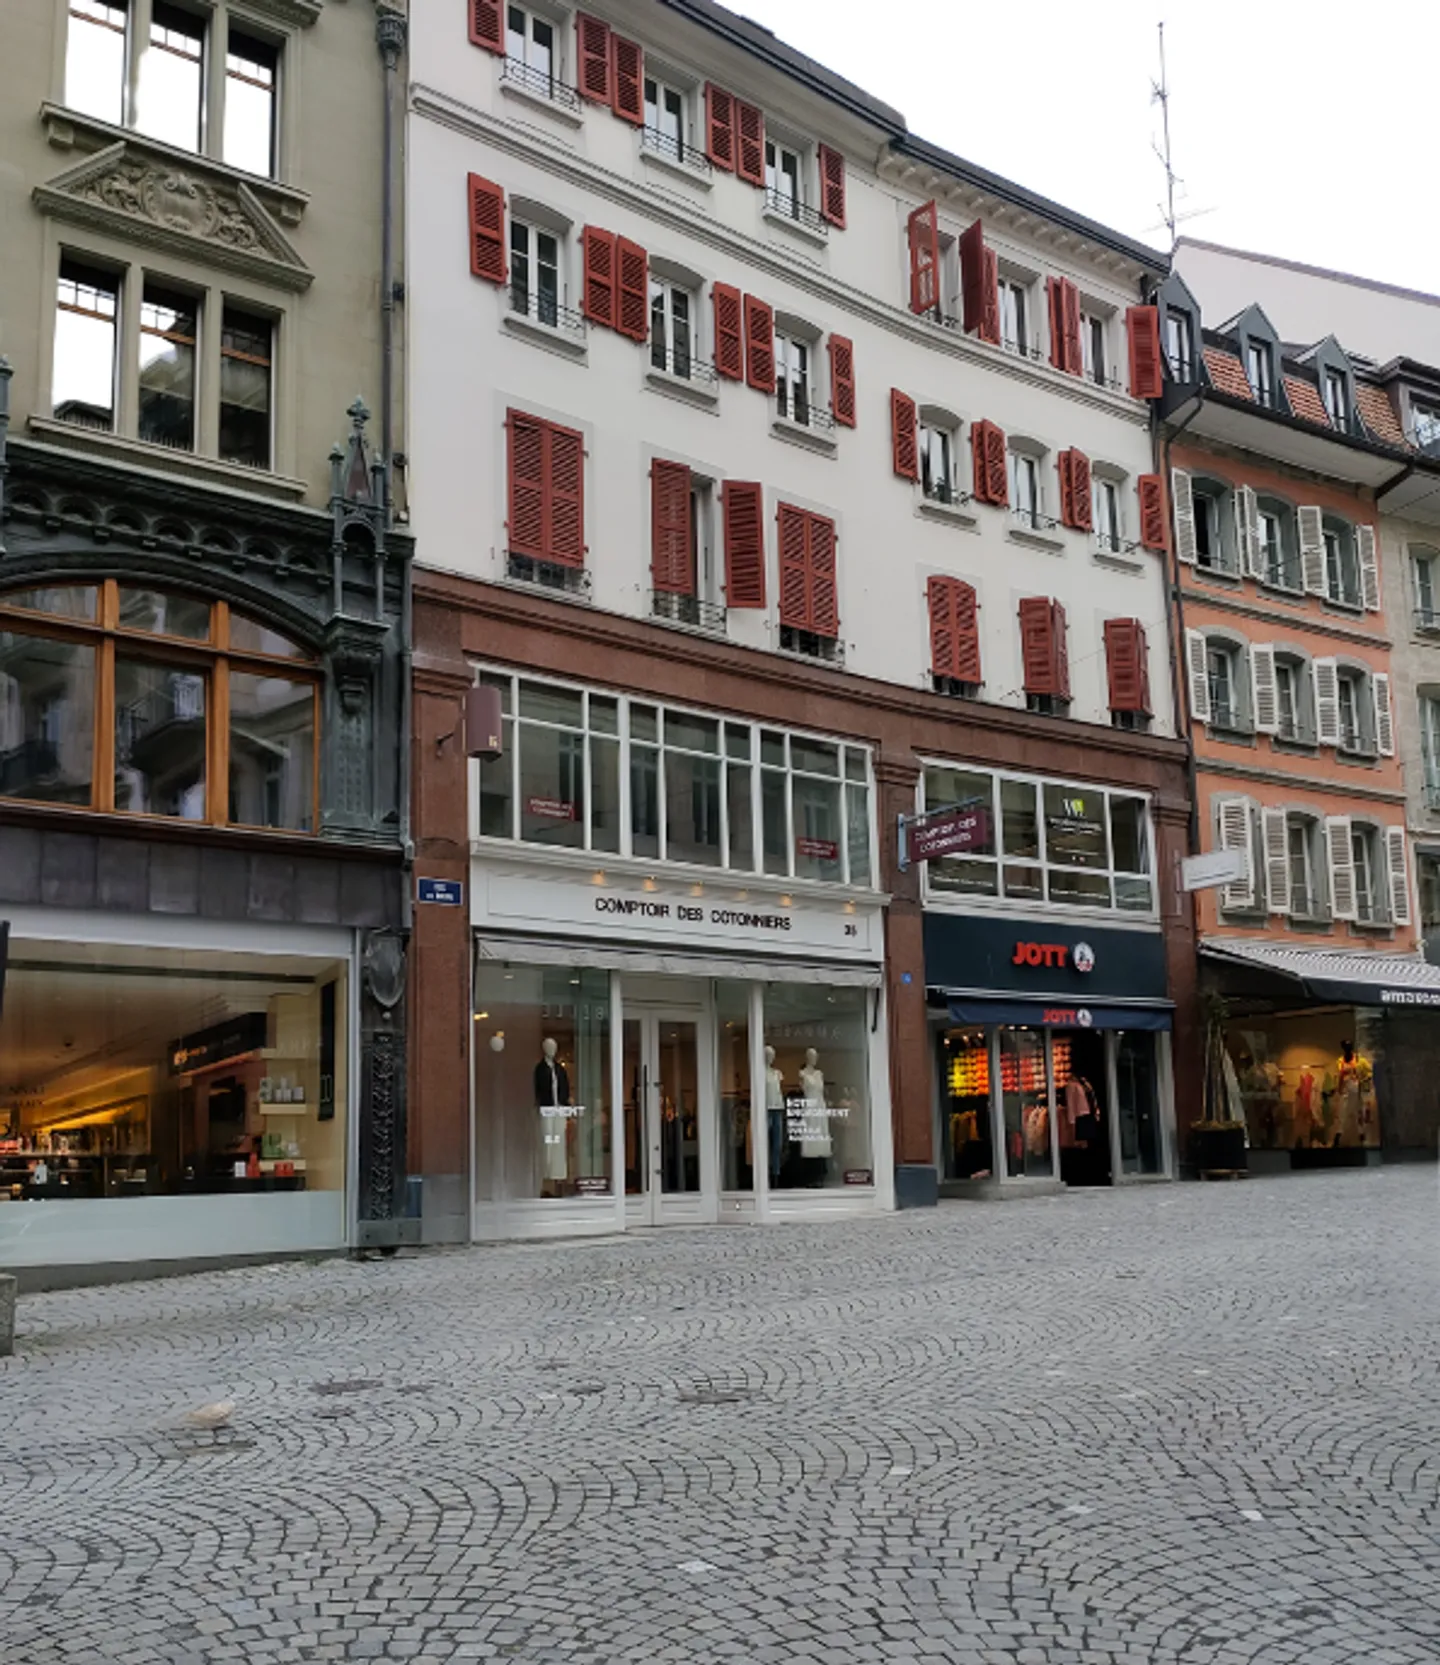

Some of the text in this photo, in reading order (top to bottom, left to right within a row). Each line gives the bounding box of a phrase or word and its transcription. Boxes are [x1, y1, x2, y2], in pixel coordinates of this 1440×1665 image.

[595, 897, 792, 931] COMPTOIR DES COTONNIERS
[1012, 941, 1068, 967] JOTT
[1042, 1008, 1076, 1024] JOTT
